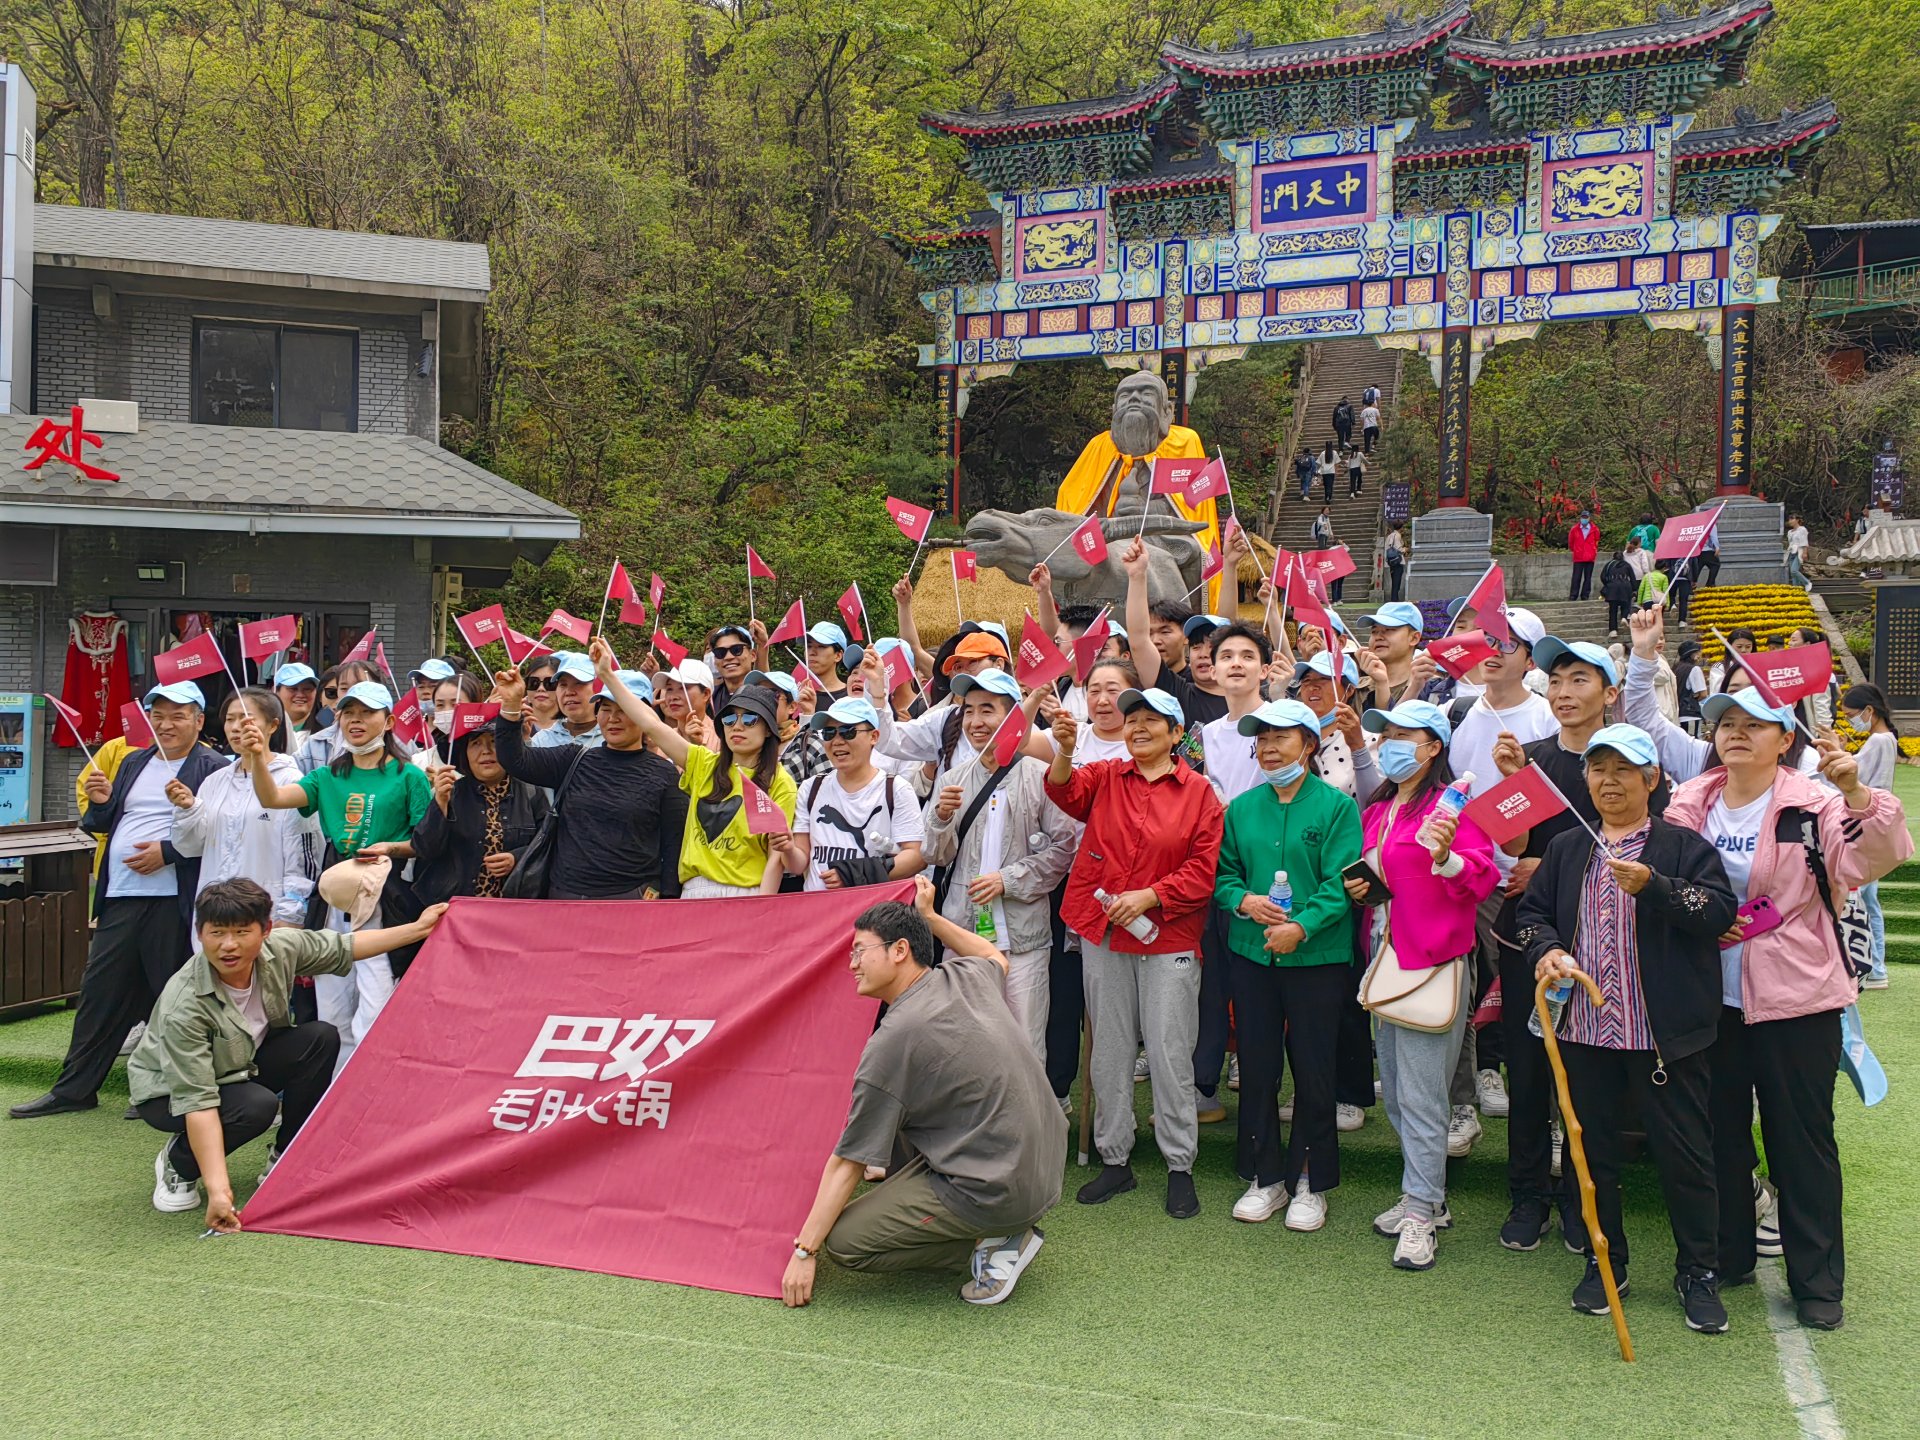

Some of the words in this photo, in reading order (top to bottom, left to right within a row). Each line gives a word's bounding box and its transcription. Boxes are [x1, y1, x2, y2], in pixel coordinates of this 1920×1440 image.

[1273, 170, 1361, 211] 中天門
[24, 405, 120, 482] 处
[1021, 640, 1044, 664] 巴奴
[1767, 667, 1800, 681] 巴奴
[364, 794, 376, 827] summer
[1714, 834, 1755, 851] BLUE
[514, 1013, 716, 1082] 巴奴
[487, 1080, 673, 1134] 毛肚火锅
